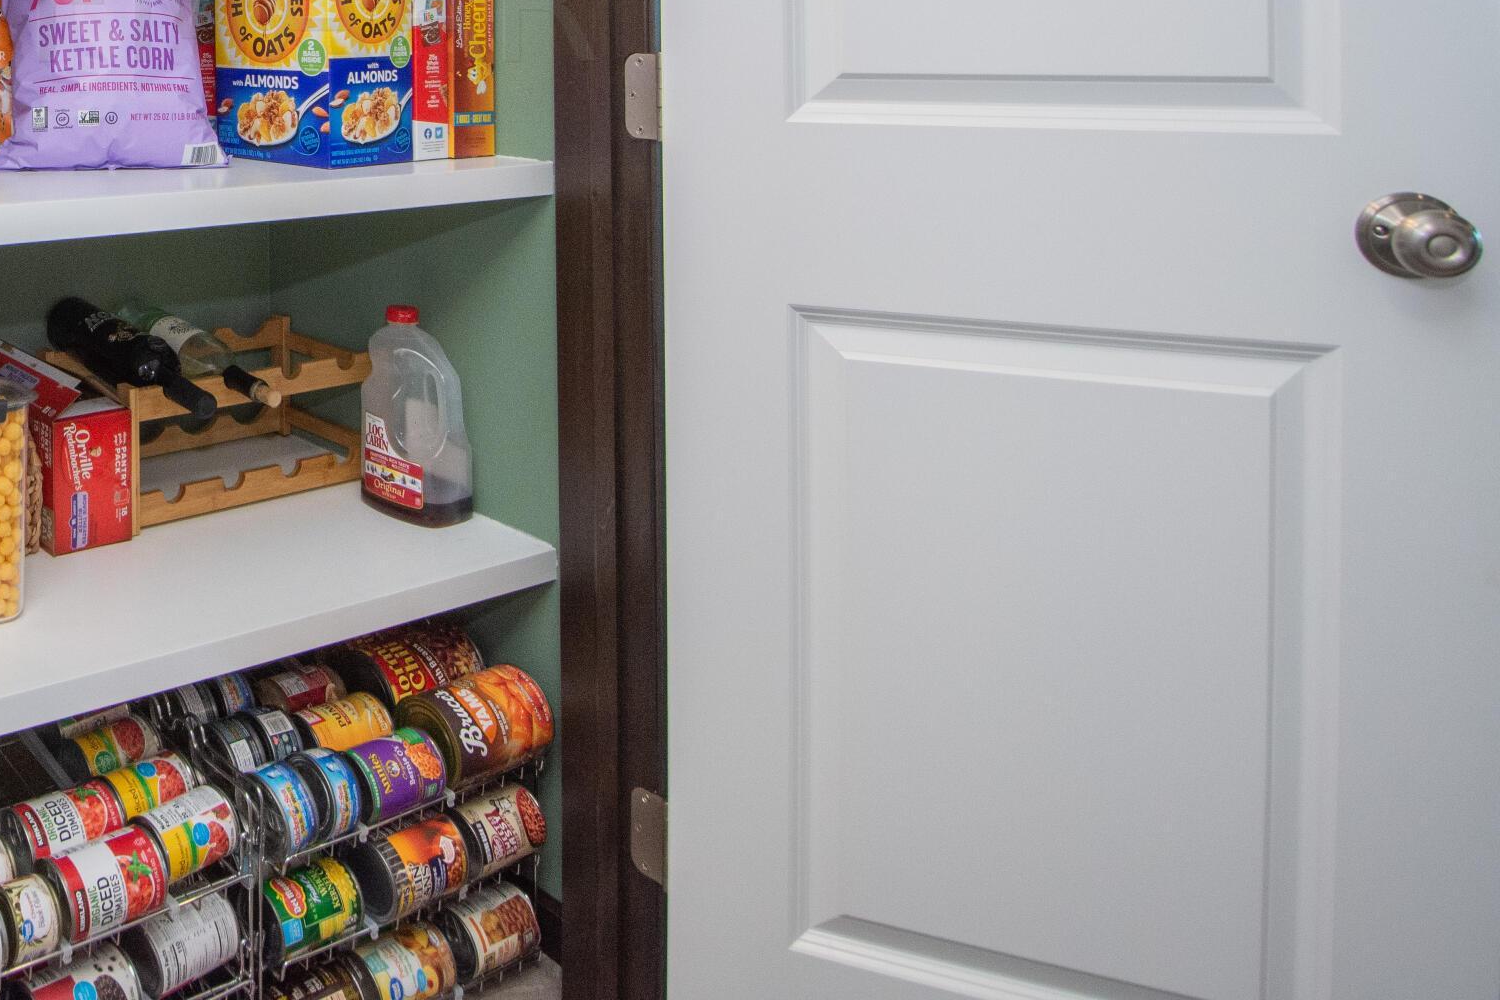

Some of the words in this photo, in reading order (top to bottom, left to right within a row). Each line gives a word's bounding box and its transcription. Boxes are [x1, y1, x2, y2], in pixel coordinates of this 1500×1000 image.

[39, 19, 102, 48] SWEET
[108, 18, 125, 42] &
[130, 19, 180, 45] SALTY
[361, 12, 396, 39] OATS
[463, 2, 472, 31] Honey
[252, 26, 296, 58] OATS
[307, 40, 315, 50] 2
[398, 37, 403, 46] 2
[50, 45, 121, 73] KETTLE
[126, 45, 175, 71] CORN
[60, 83, 88, 93] SIMPLE
[140, 82, 172, 93] NOTHING
[232, 79, 243, 87] with
[244, 74, 299, 89] ALMONDS
[347, 70, 398, 84] ALMONDS
[366, 433, 389, 454] CABIN
[368, 422, 384, 439] LOG
[63, 422, 84, 492] Redenbacher's
[74, 429, 95, 480] Orville
[120, 446, 128, 487] PANTRY
[374, 479, 405, 499] Original
[391, 642, 426, 690] Chili
[412, 643, 437, 668] Beans
[435, 690, 488, 758] Bruce's
[457, 689, 494, 732] YAMS
[368, 753, 394, 795] Annie's
[402, 757, 416, 786] Bernie
[24, 811, 45, 847] KIRKLAND
[39, 807, 57, 841] ORGANIC
[44, 800, 72, 842] DICED
[60, 797, 81, 837] TOMATOES
[87, 886, 101, 929] ORGANIC
[97, 876, 114, 926] DICED
[109, 873, 122, 920] TOMATOES
[290, 897, 302, 915] Del
[321, 876, 341, 910] KERNEL
[75, 891, 87, 932] KIRKLAND
